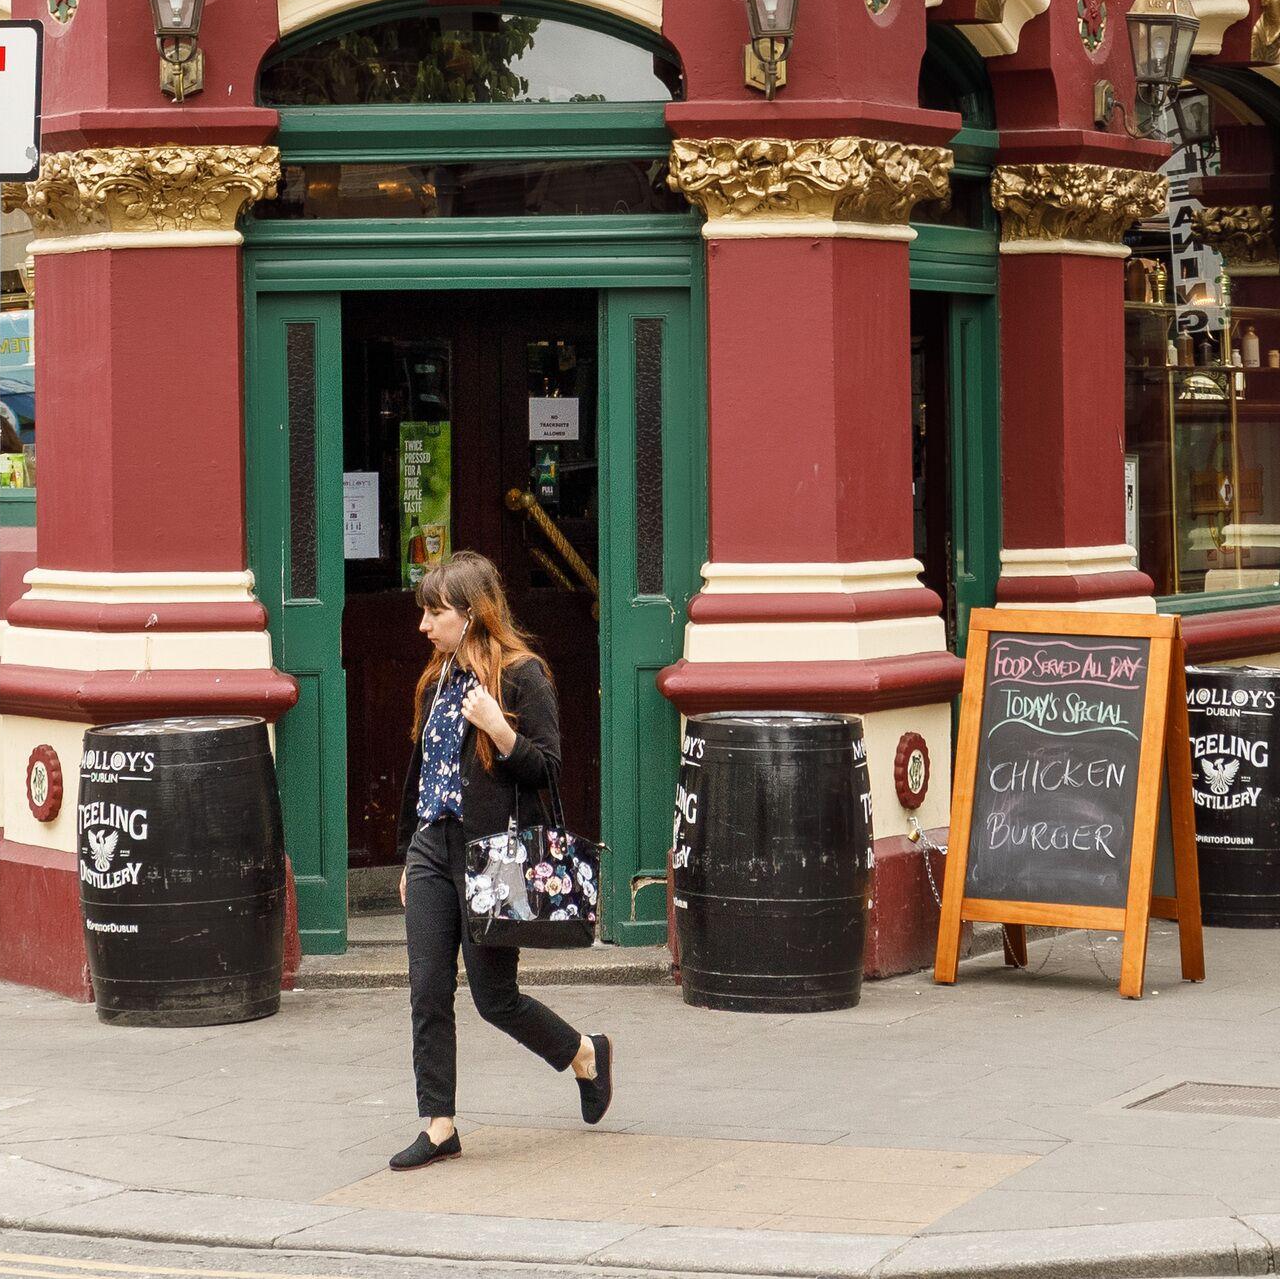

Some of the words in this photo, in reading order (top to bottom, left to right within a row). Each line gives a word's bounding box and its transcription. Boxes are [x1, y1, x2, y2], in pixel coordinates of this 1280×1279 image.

[404, 440, 423, 452] TWICE
[404, 452, 431, 464] PRESSED
[404, 465, 416, 477] FOR
[404, 477, 419, 489] TRUE
[403, 489, 423, 501] APPLE
[403, 501, 423, 513] TASTE
[994, 647, 1032, 680] FOOD
[1032, 649, 1081, 679] SERVED
[1081, 653, 1107, 679] ALL
[1107, 655, 1147, 682] DAY
[1000, 689, 1061, 727] TODAY'S
[1063, 692, 1129, 725] SPECIAL
[1206, 707, 1241, 717] DUBLIN
[1190, 733, 1269, 768] EELING
[90, 772, 119, 783] DUBLIN
[989, 759, 1127, 794] CHICKEN
[1193, 786, 1262, 810] ISTILLERY
[78, 801, 148, 841] TEELING
[986, 811, 1116, 859] BURGER
[1195, 832, 1254, 846] SPIRITOFDUBLIN
[80, 861, 143, 890] DISTILLERY
